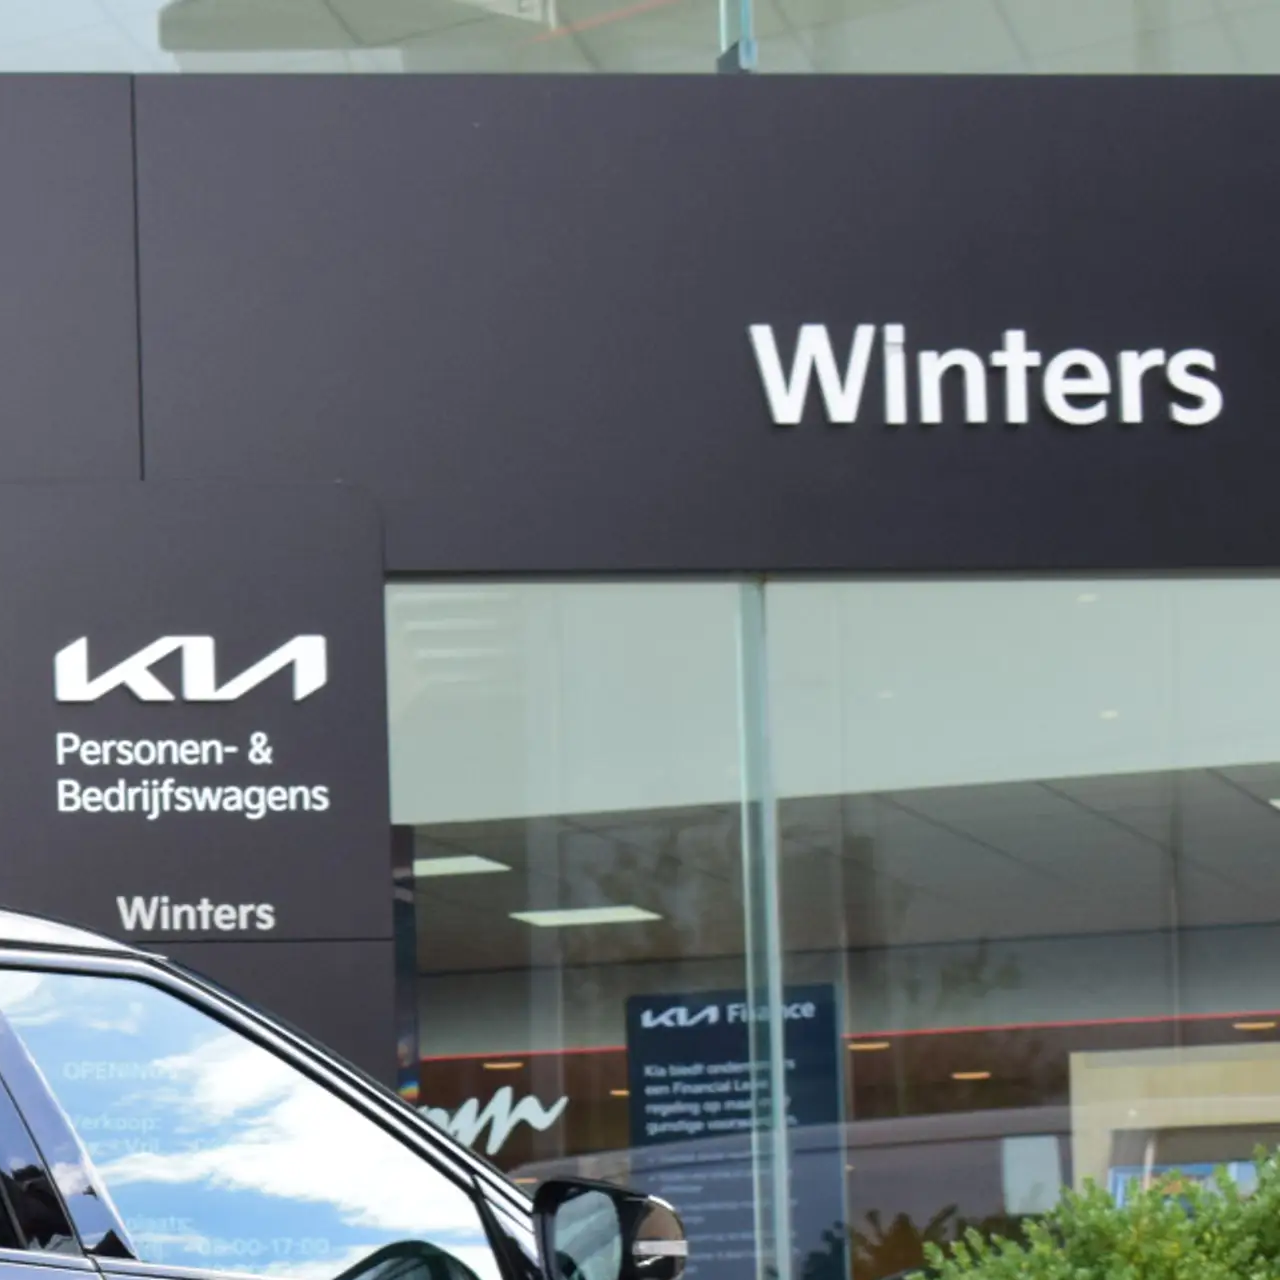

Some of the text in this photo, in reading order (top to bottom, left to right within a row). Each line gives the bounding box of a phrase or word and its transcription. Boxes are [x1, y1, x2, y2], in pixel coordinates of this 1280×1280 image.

[749, 322, 1224, 426] Winters
[54, 634, 328, 702] KIA
[56, 731, 274, 766] Personen- &
[57, 778, 331, 821] Bedrijfswagens
[116, 895, 276, 931] Winters
[641, 1005, 720, 1029] KIA
